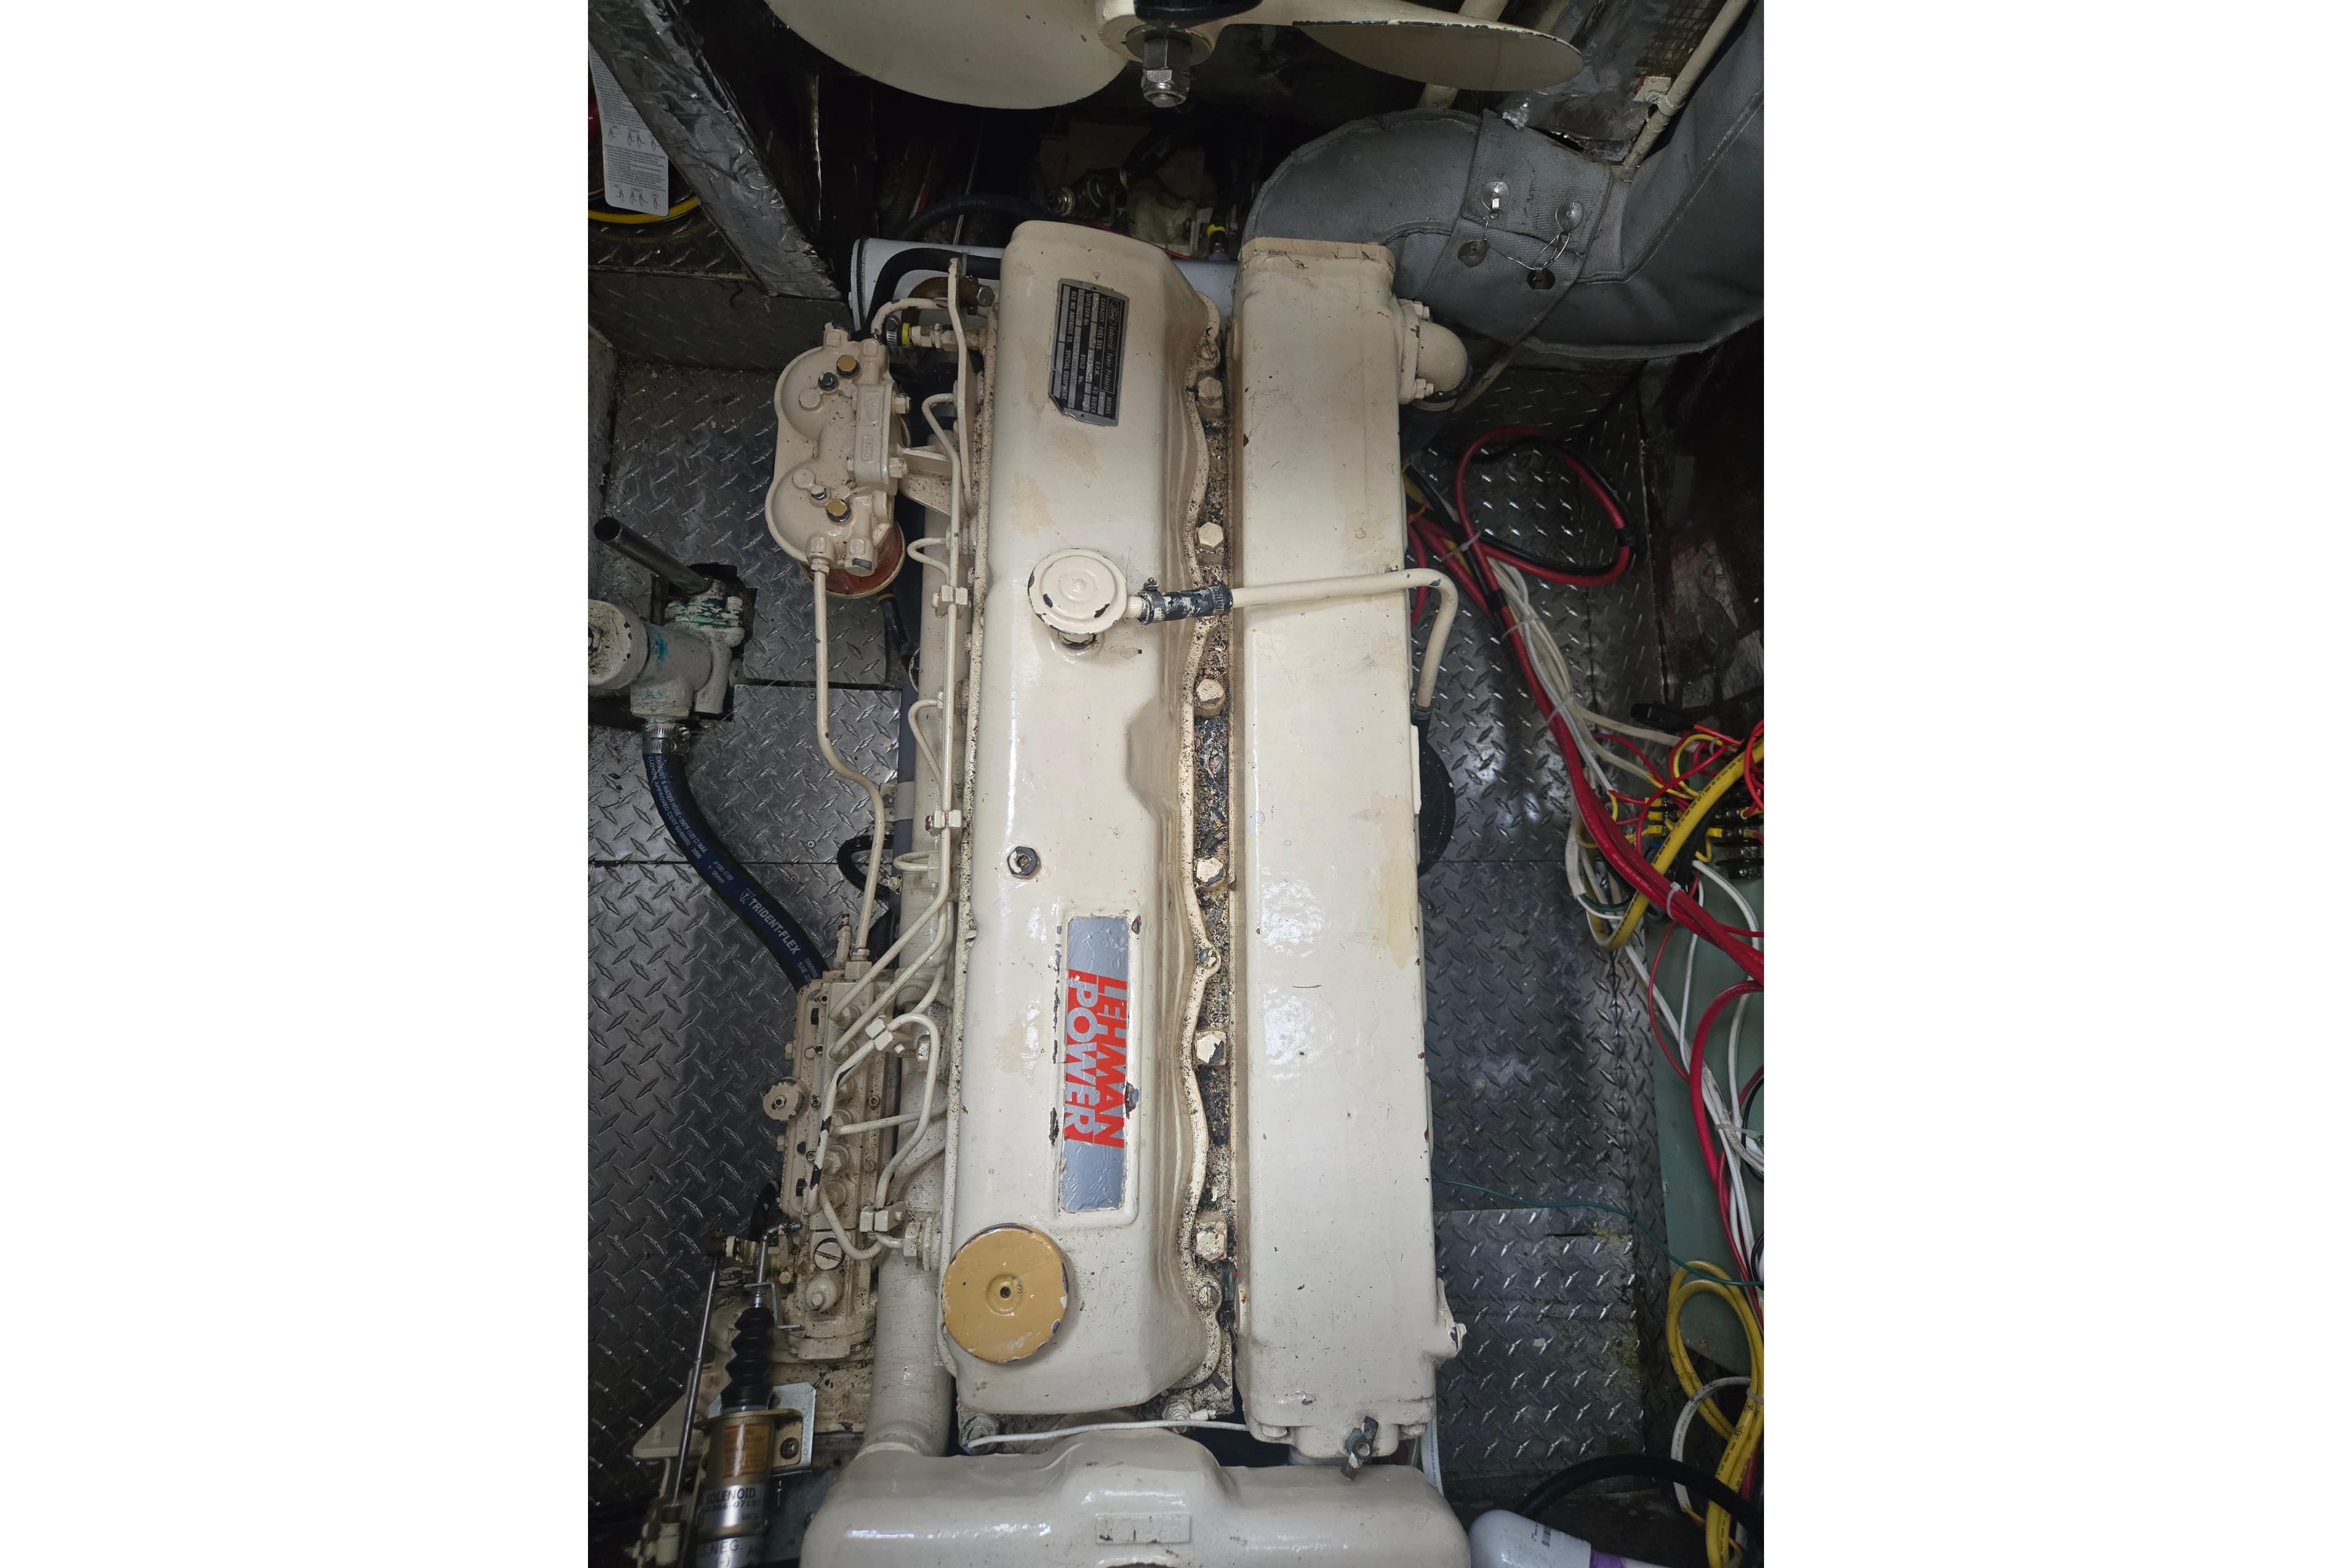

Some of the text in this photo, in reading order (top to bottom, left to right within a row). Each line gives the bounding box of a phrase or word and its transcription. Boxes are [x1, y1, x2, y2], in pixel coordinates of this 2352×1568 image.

[1061, 371, 1069, 400] EQUIPMENT
[654, 781, 670, 812] APPROVED
[667, 811, 677, 825] CERT
[663, 785, 674, 803] WATER
[671, 802, 681, 816] HOSE
[748, 898, 801, 955] TRIDENT-FLEX
[797, 962, 807, 974] SAE
[804, 958, 819, 978] MARINE
[1065, 976, 1101, 1140] POWER
[1093, 974, 1128, 1149] LEHMAN
[706, 1487, 756, 1504] SOLENOID
